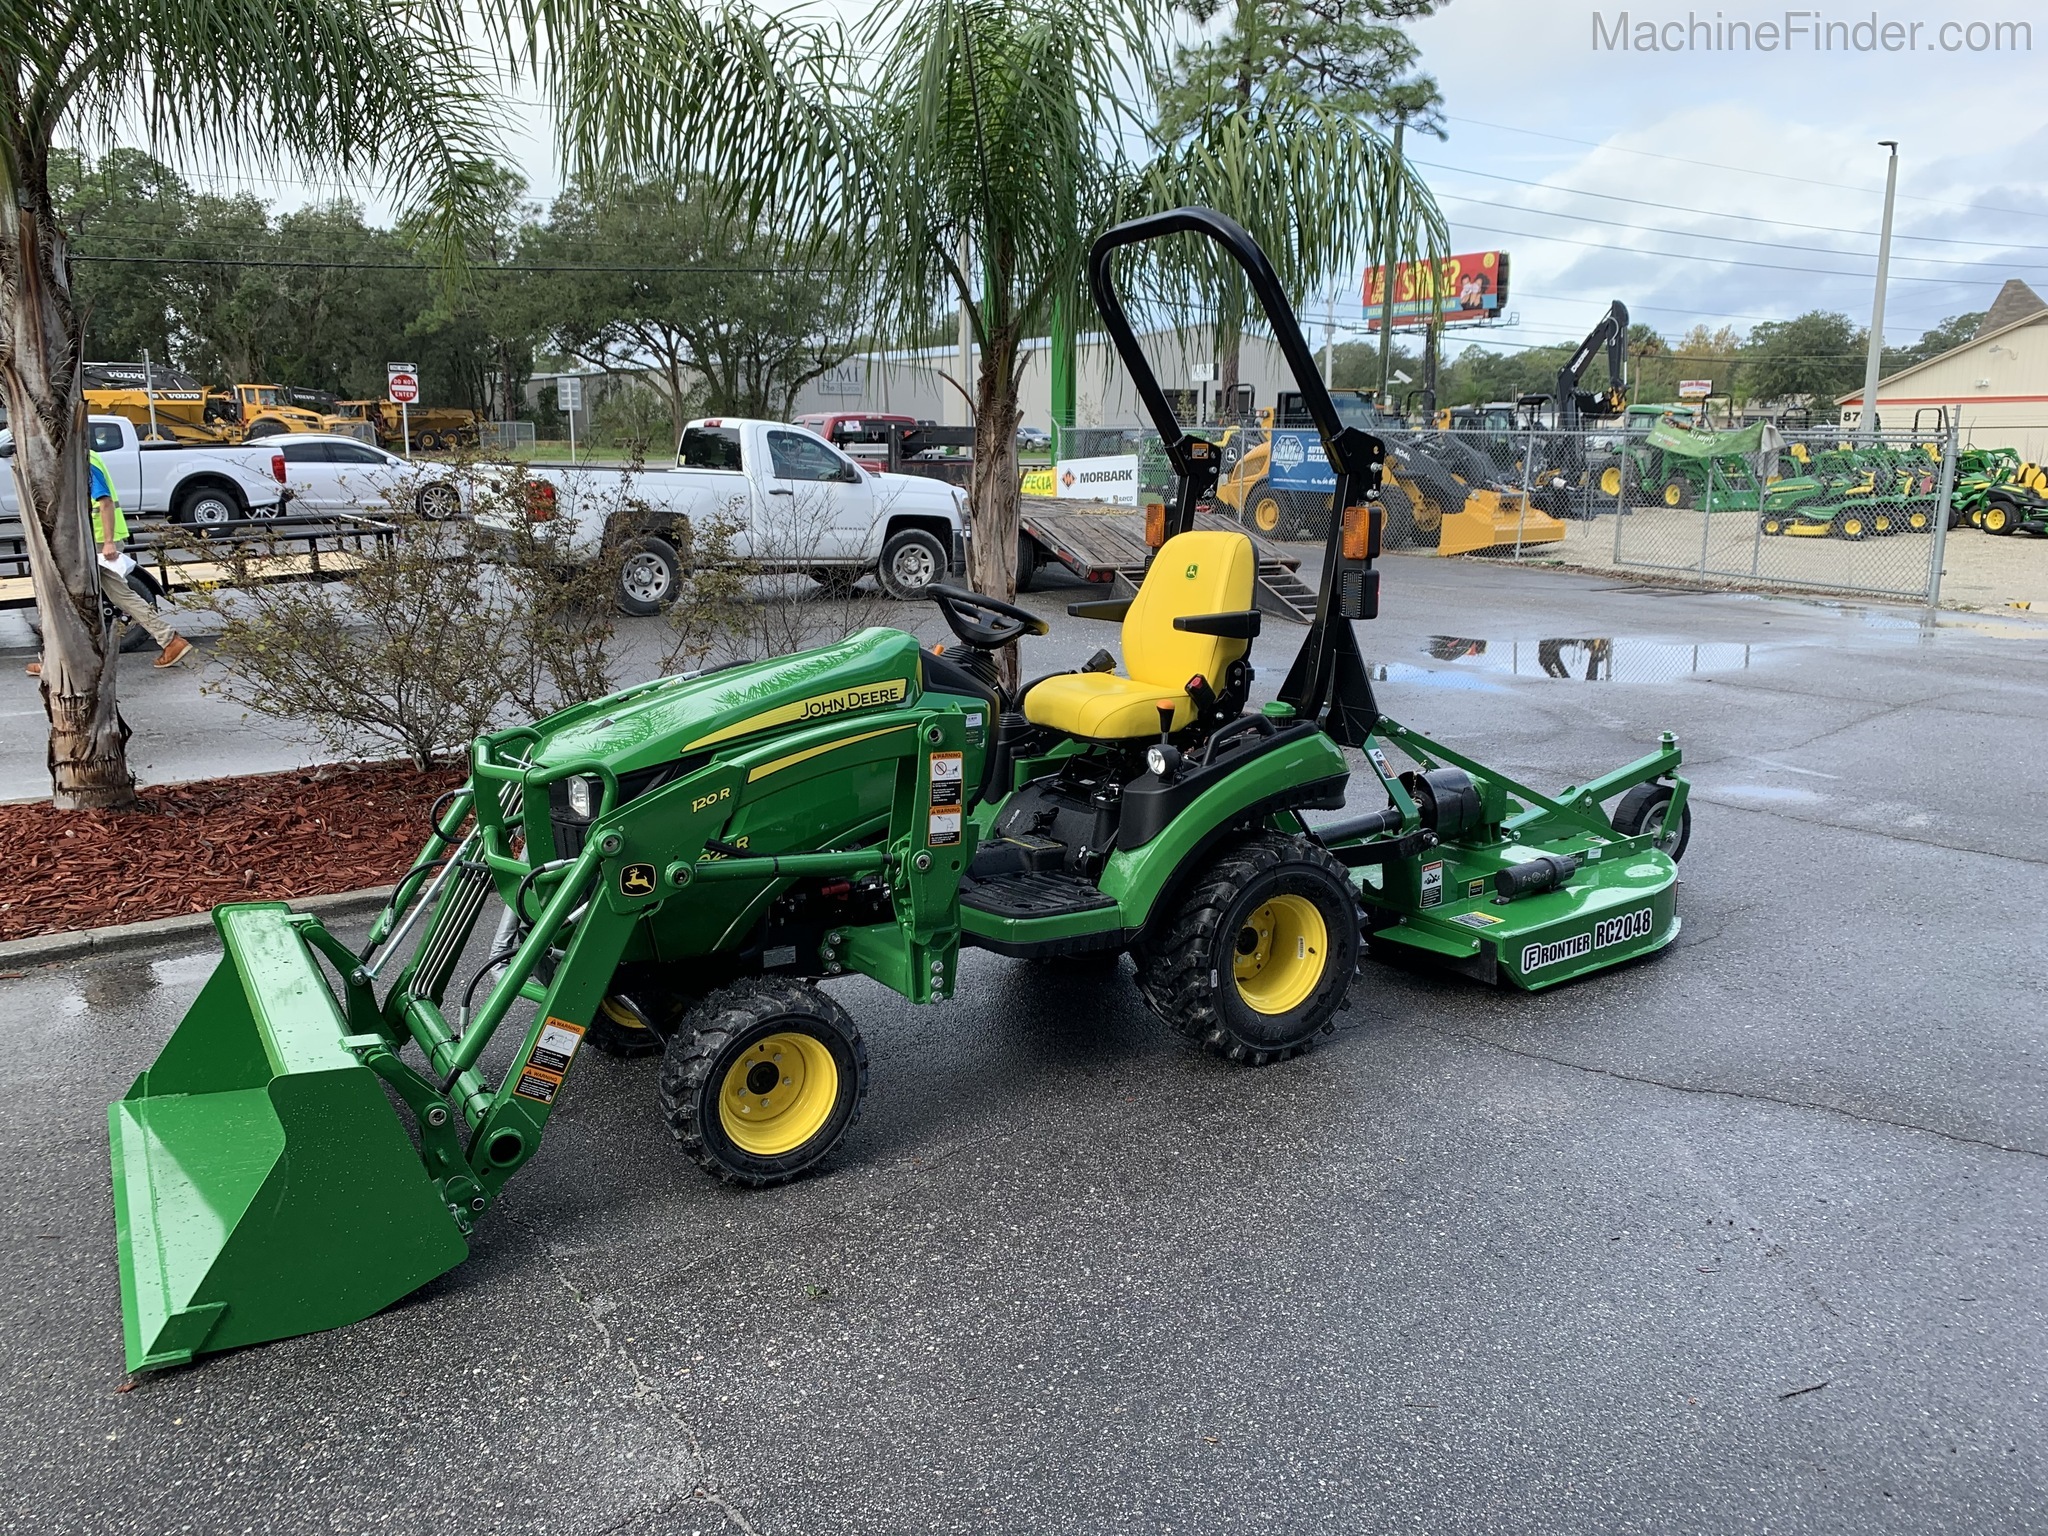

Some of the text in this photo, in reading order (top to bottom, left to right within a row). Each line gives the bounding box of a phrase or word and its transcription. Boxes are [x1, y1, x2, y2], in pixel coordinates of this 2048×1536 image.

[107, 371, 145, 380] VOLVO
[1844, 411, 1861, 422] 87
[1079, 469, 1133, 484] MORBARK
[800, 688, 899, 719] JOHN DEERE
[937, 752, 961, 760] WARNING
[692, 787, 731, 813] 120 R
[1523, 909, 1652, 972] FRONTIER RC2048
[556, 1021, 580, 1033] WARNING
[533, 1071, 558, 1082] WARNING
